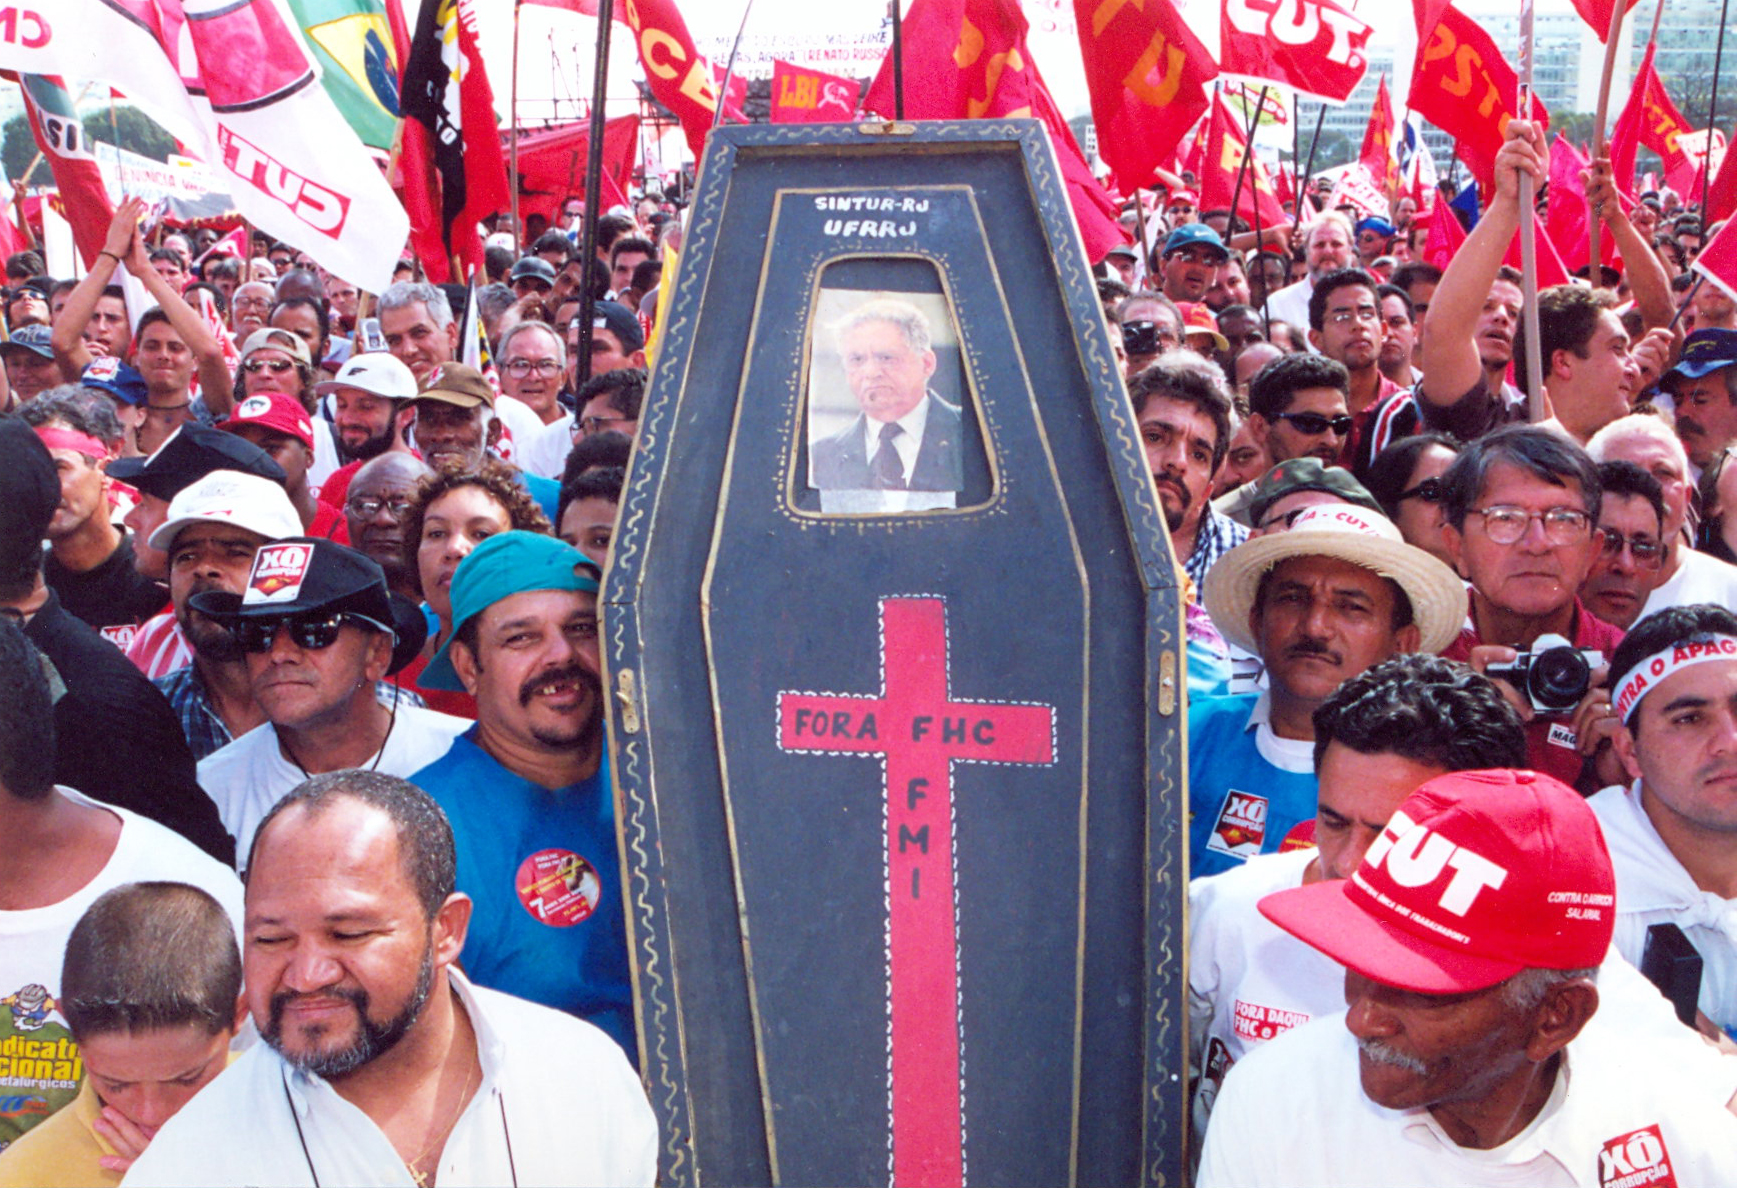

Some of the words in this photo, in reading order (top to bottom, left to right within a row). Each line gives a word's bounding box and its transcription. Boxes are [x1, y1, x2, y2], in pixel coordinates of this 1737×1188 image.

[778, 75, 820, 109] LBI
[814, 196, 930, 212] SINTUR-RJ
[823, 219, 918, 238] UFRRJ
[1650, 658, 1665, 677] O
[795, 708, 879, 741] FORA
[911, 715, 997, 747] FHC
[1236, 1002, 1265, 1021] FORA
[1235, 1016, 1260, 1037] FHC
[1600, 1130, 1664, 1181] XÔ
